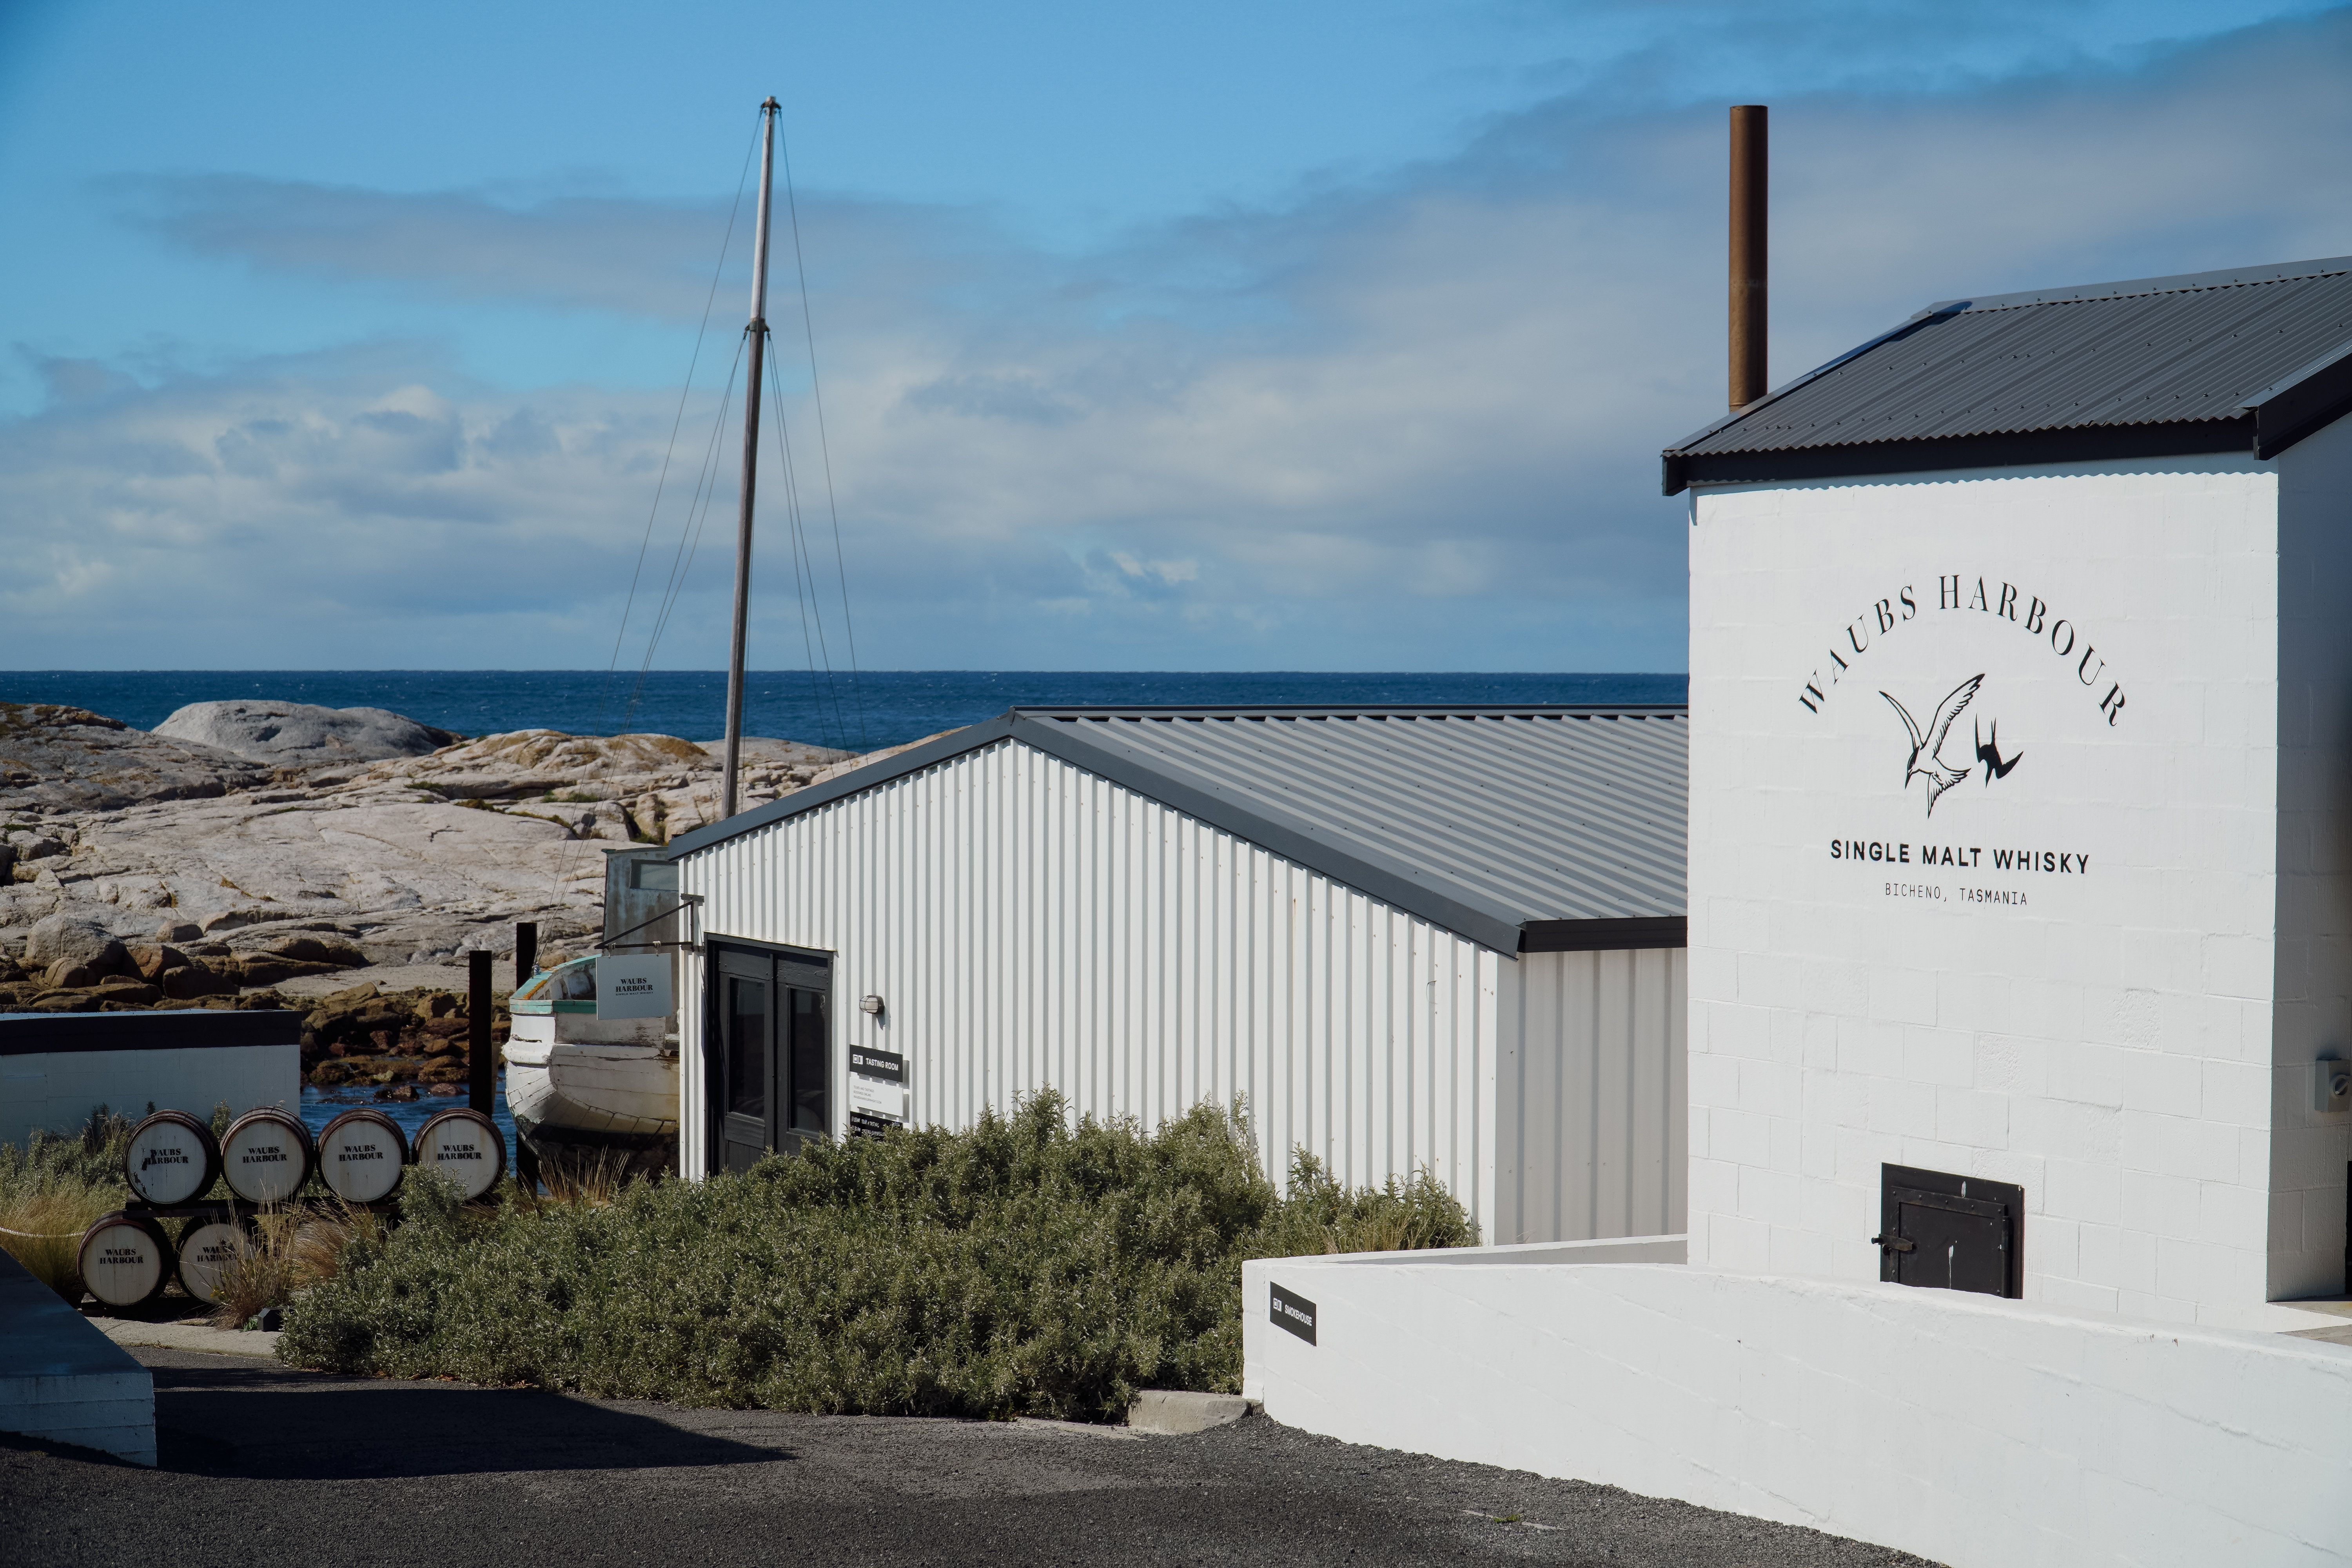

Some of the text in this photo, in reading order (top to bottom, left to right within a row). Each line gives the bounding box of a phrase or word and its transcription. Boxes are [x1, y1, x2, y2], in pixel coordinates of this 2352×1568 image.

[1798, 575, 2125, 726] WAUBS HARBOUR
[1831, 840, 2089, 873] SINGLE MALT WHISKY
[1886, 883, 2026, 905] BICHENO, TASMANIA
[866, 1058, 898, 1071] TASTING ROOM
[243, 1154, 287, 1163] HARBOUR
[339, 1152, 383, 1161] HARBOUR
[437, 1152, 482, 1160] HARBOUR
[100, 1256, 143, 1264] HARBOUR
[1285, 1304, 1312, 1326] SMOKEHOUSE
